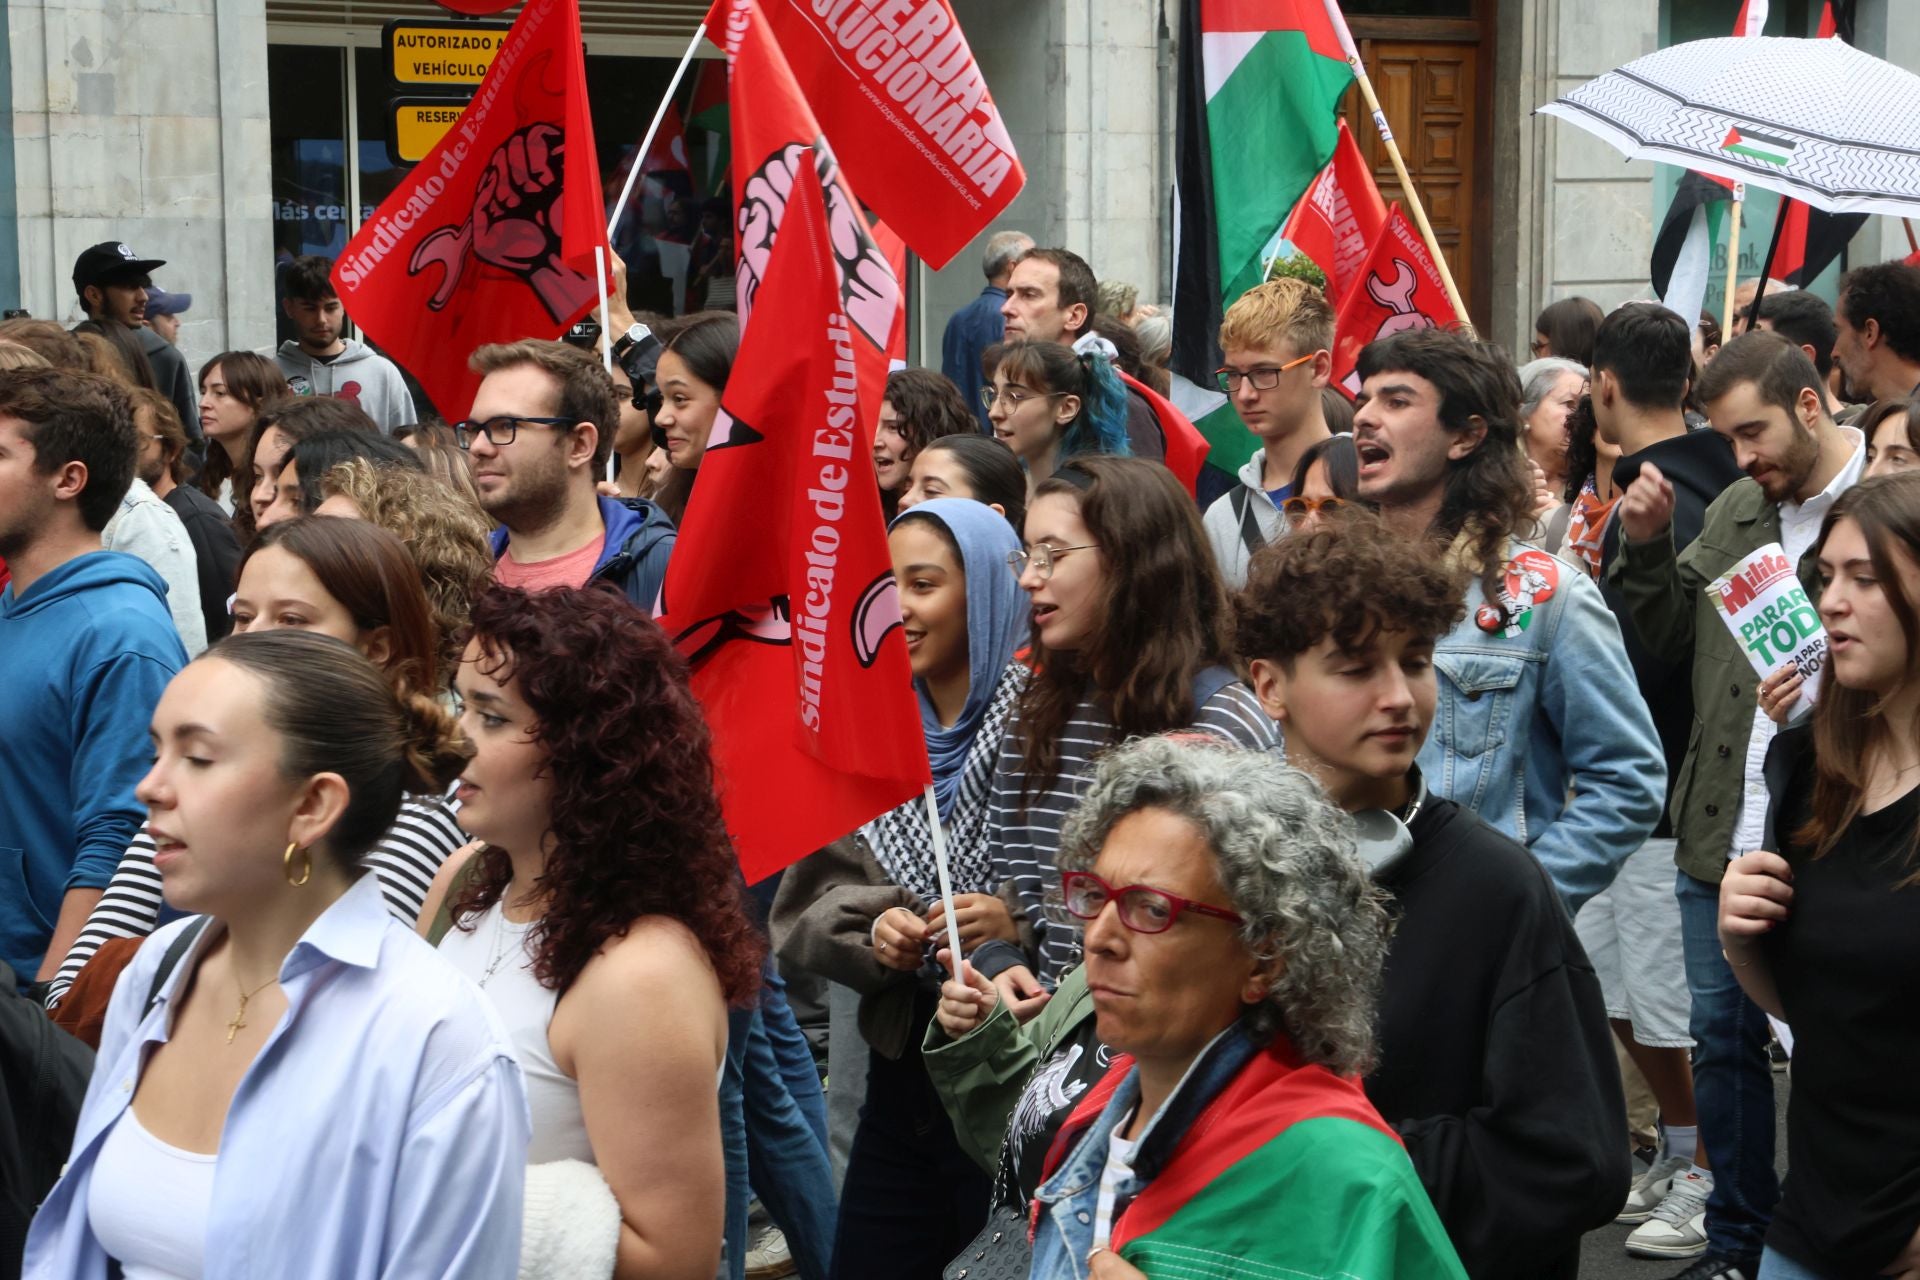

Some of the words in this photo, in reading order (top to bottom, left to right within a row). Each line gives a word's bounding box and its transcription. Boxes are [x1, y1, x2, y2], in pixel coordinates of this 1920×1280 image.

[397, 35, 492, 50] AUTORIZADO
[413, 60, 488, 77] VEHÍCULO
[861, 0, 987, 114] ERDA
[339, 175, 445, 293] Sindicato
[440, 140, 469, 179] de
[460, 0, 555, 145] Estudiante
[858, 82, 982, 210] www.izquierdarevolucionaria.net
[807, 464, 848, 521] de
[1739, 588, 1809, 642] PARAR
